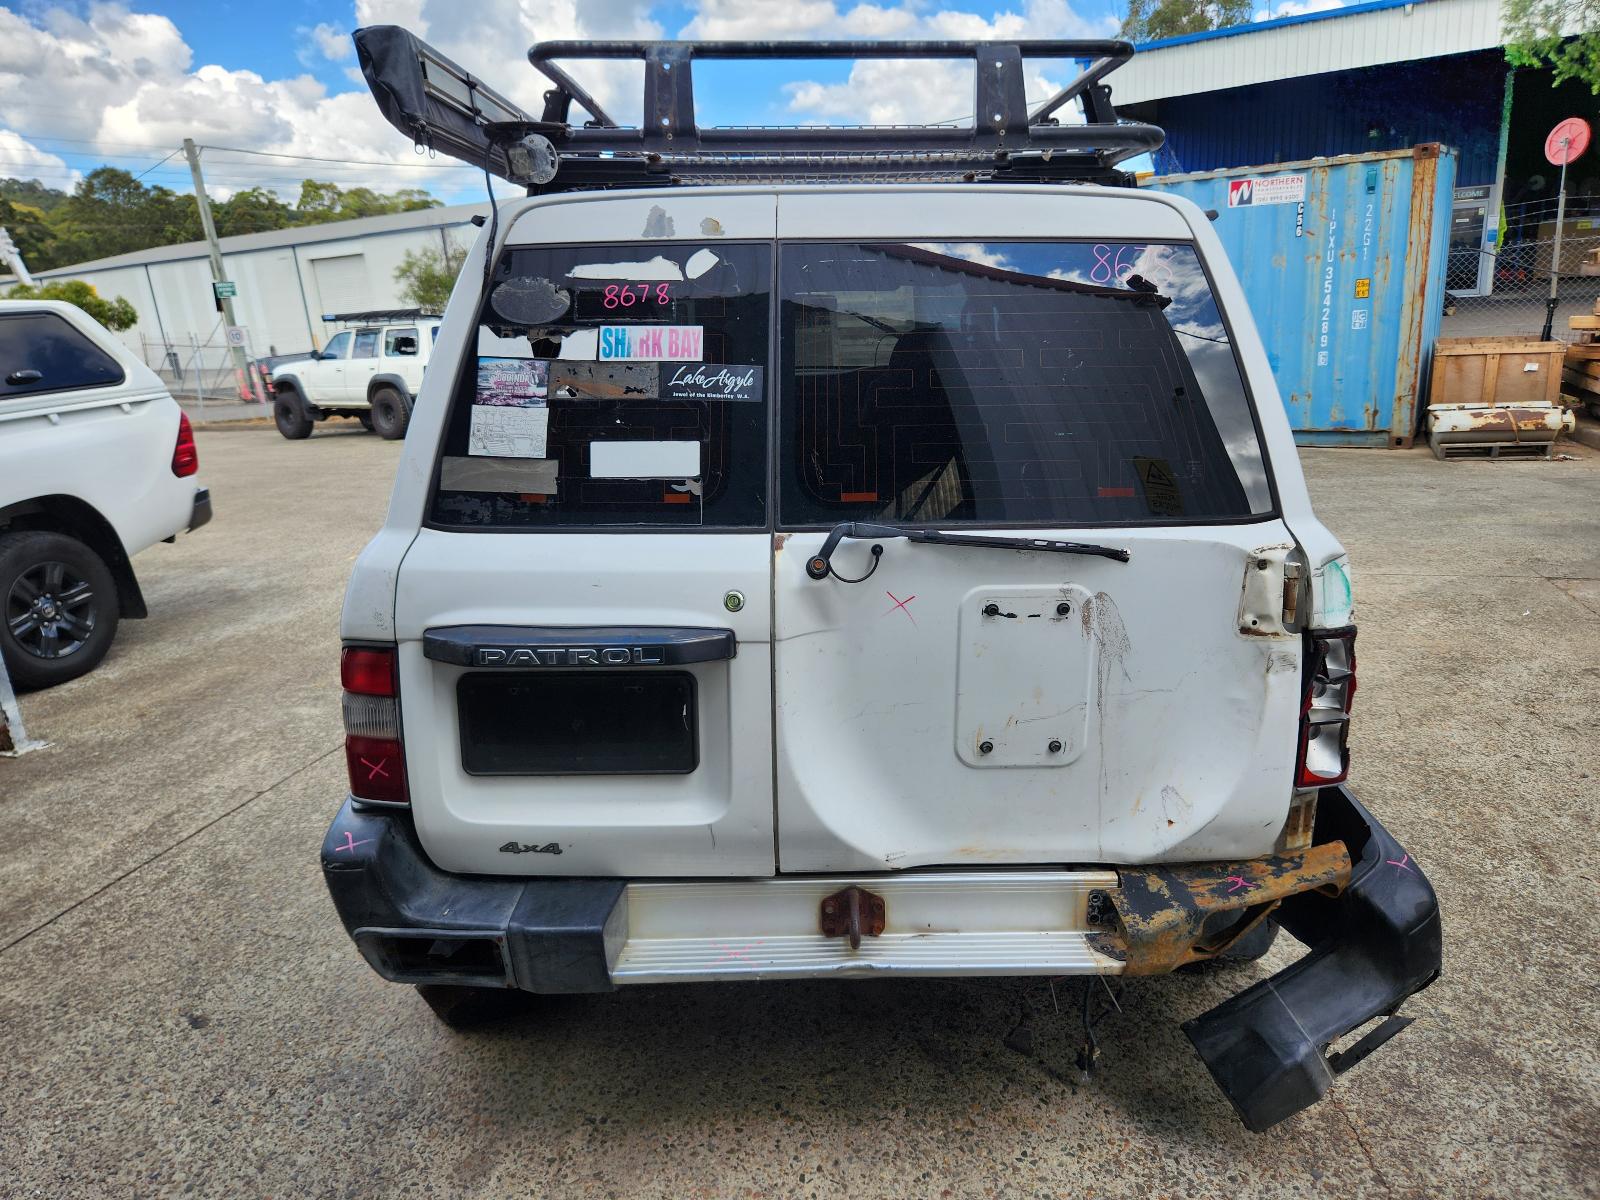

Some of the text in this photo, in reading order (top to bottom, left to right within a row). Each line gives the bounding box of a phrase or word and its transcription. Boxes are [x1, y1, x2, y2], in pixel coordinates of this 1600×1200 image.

[1254, 176, 1303, 187] NORTHERN
[1453, 190, 1484, 199] ELCOME
[603, 283, 670, 309] 8678
[668, 328, 702, 358] BAY
[668, 366, 754, 393] Lake Argyle
[479, 648, 664, 665] PATROL
[500, 842, 563, 854] 4x4
